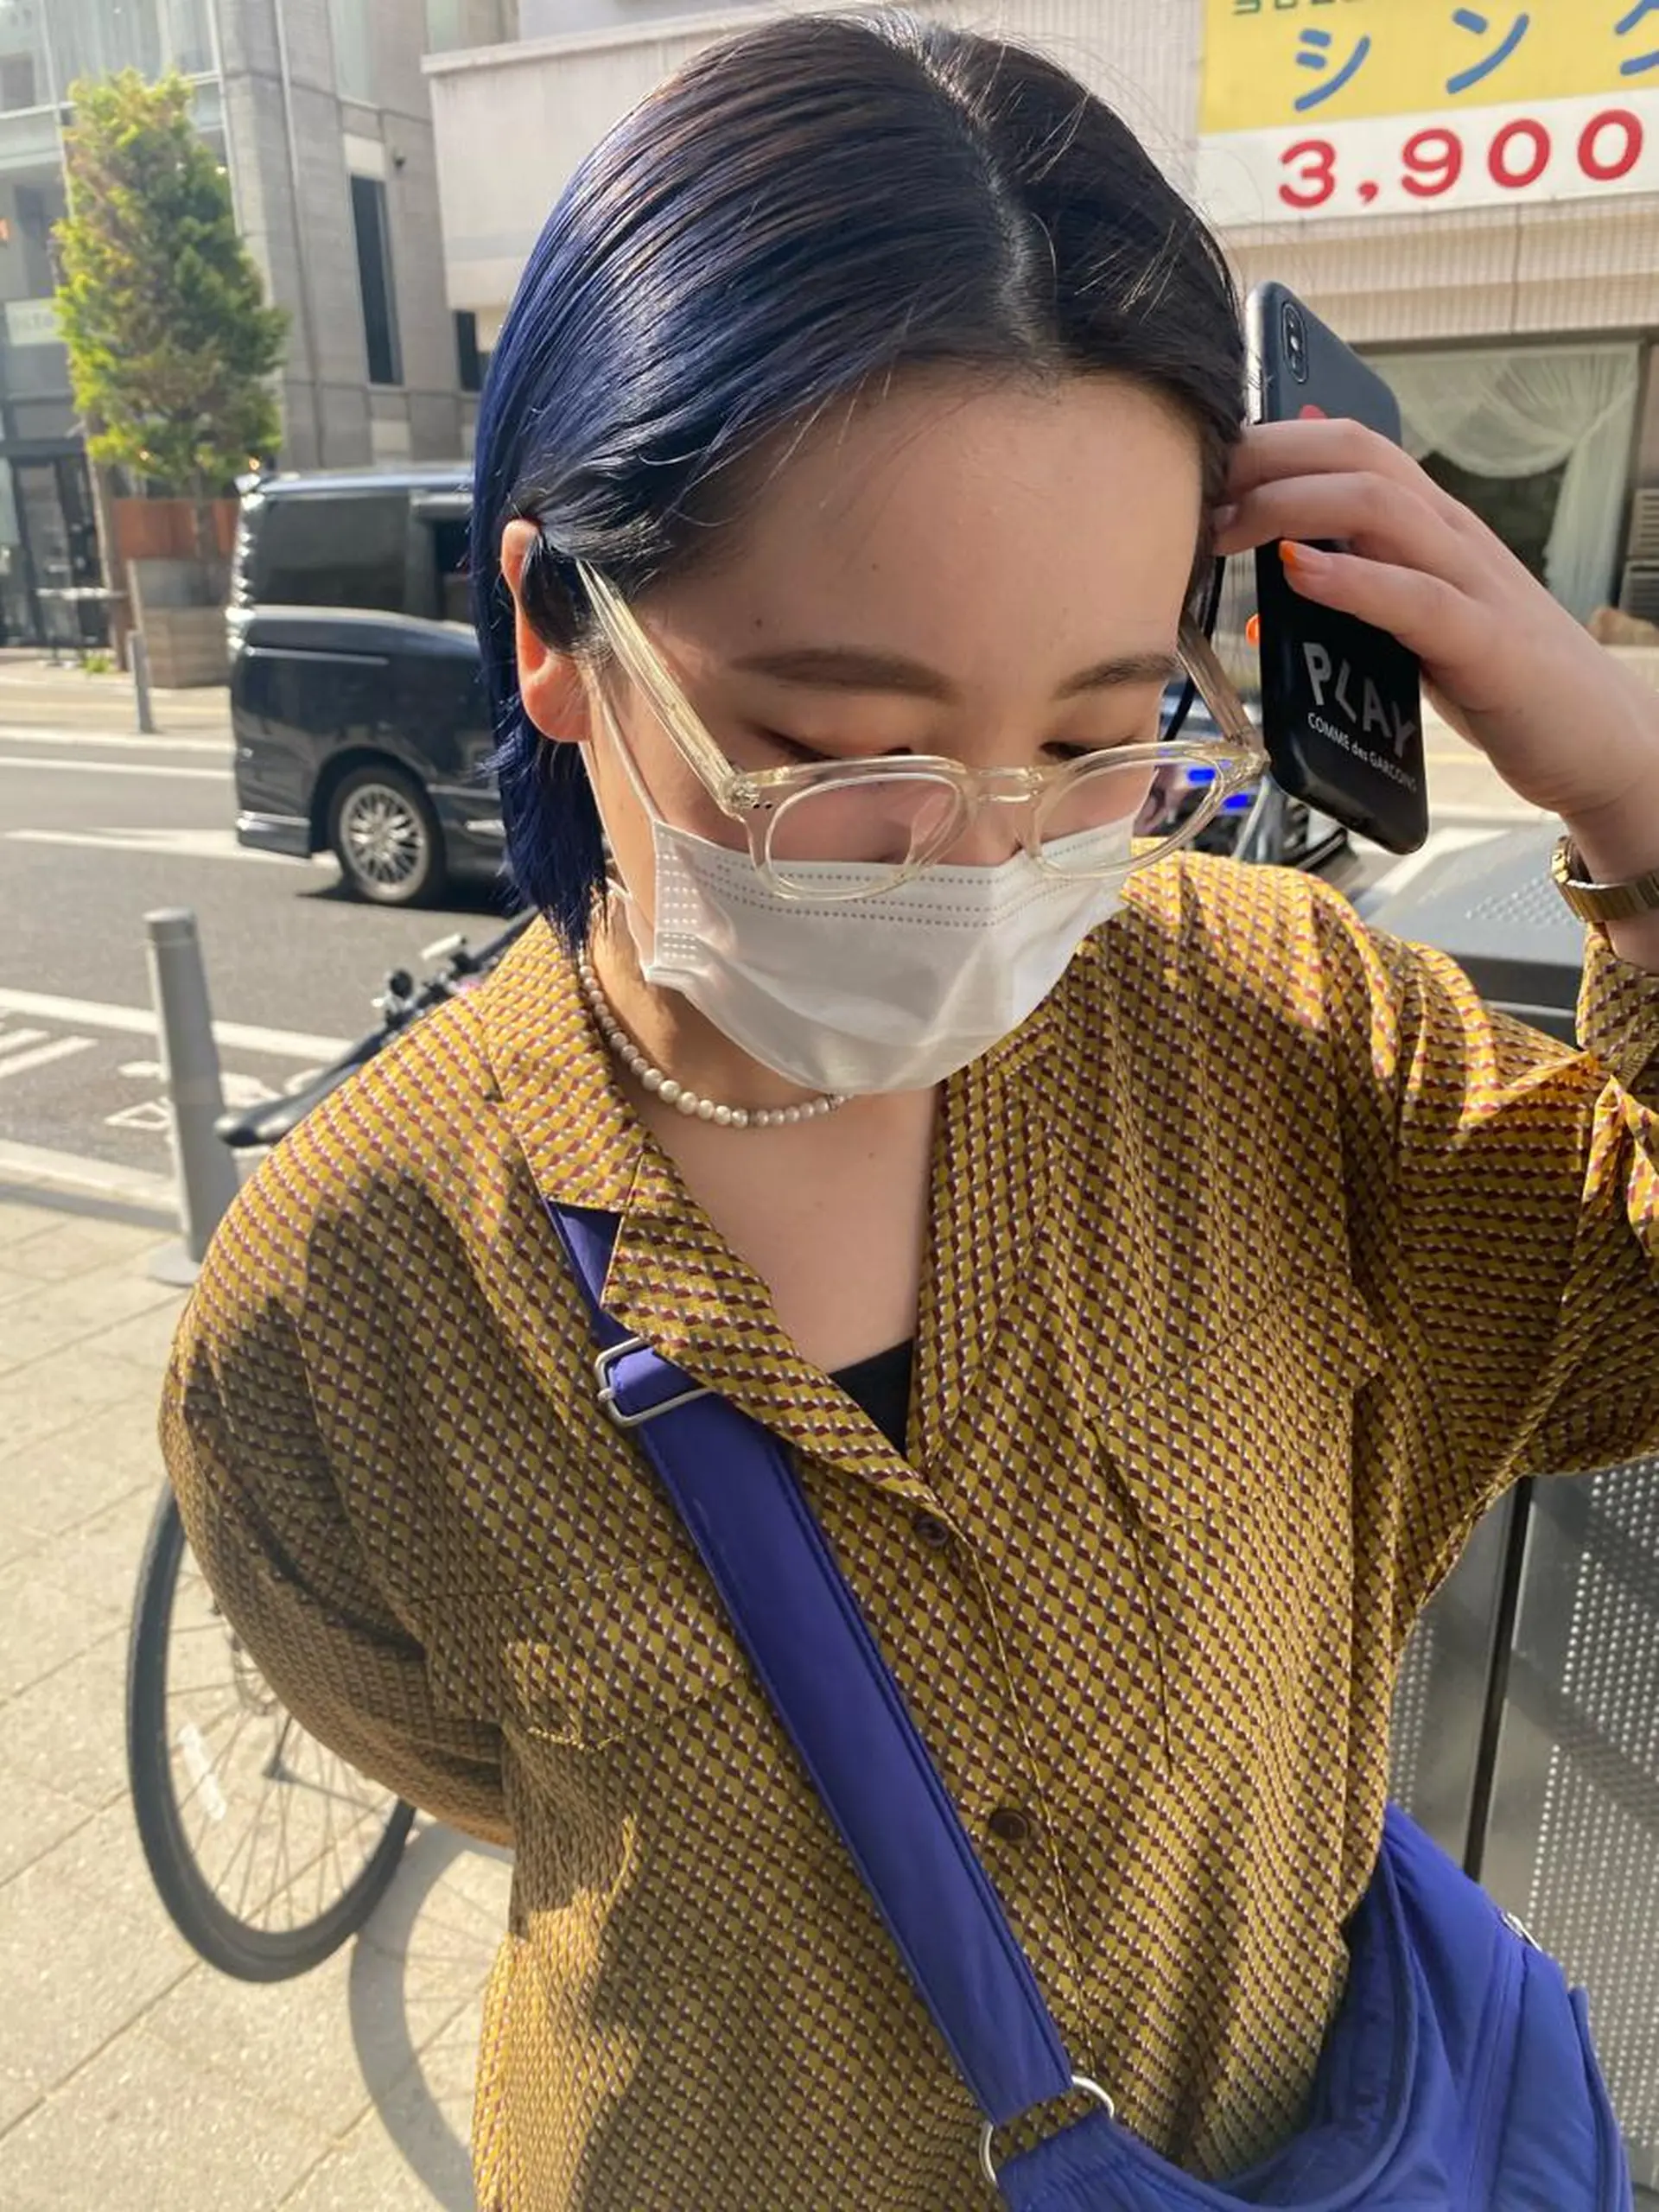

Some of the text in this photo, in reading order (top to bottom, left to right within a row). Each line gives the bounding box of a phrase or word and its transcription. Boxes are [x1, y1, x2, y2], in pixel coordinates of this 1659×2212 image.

[1279, 109, 1643, 207] 3,900
[1303, 642, 1416, 758] PLAY
[1307, 711, 1351, 751] COMME
[1351, 741, 1369, 761] des
